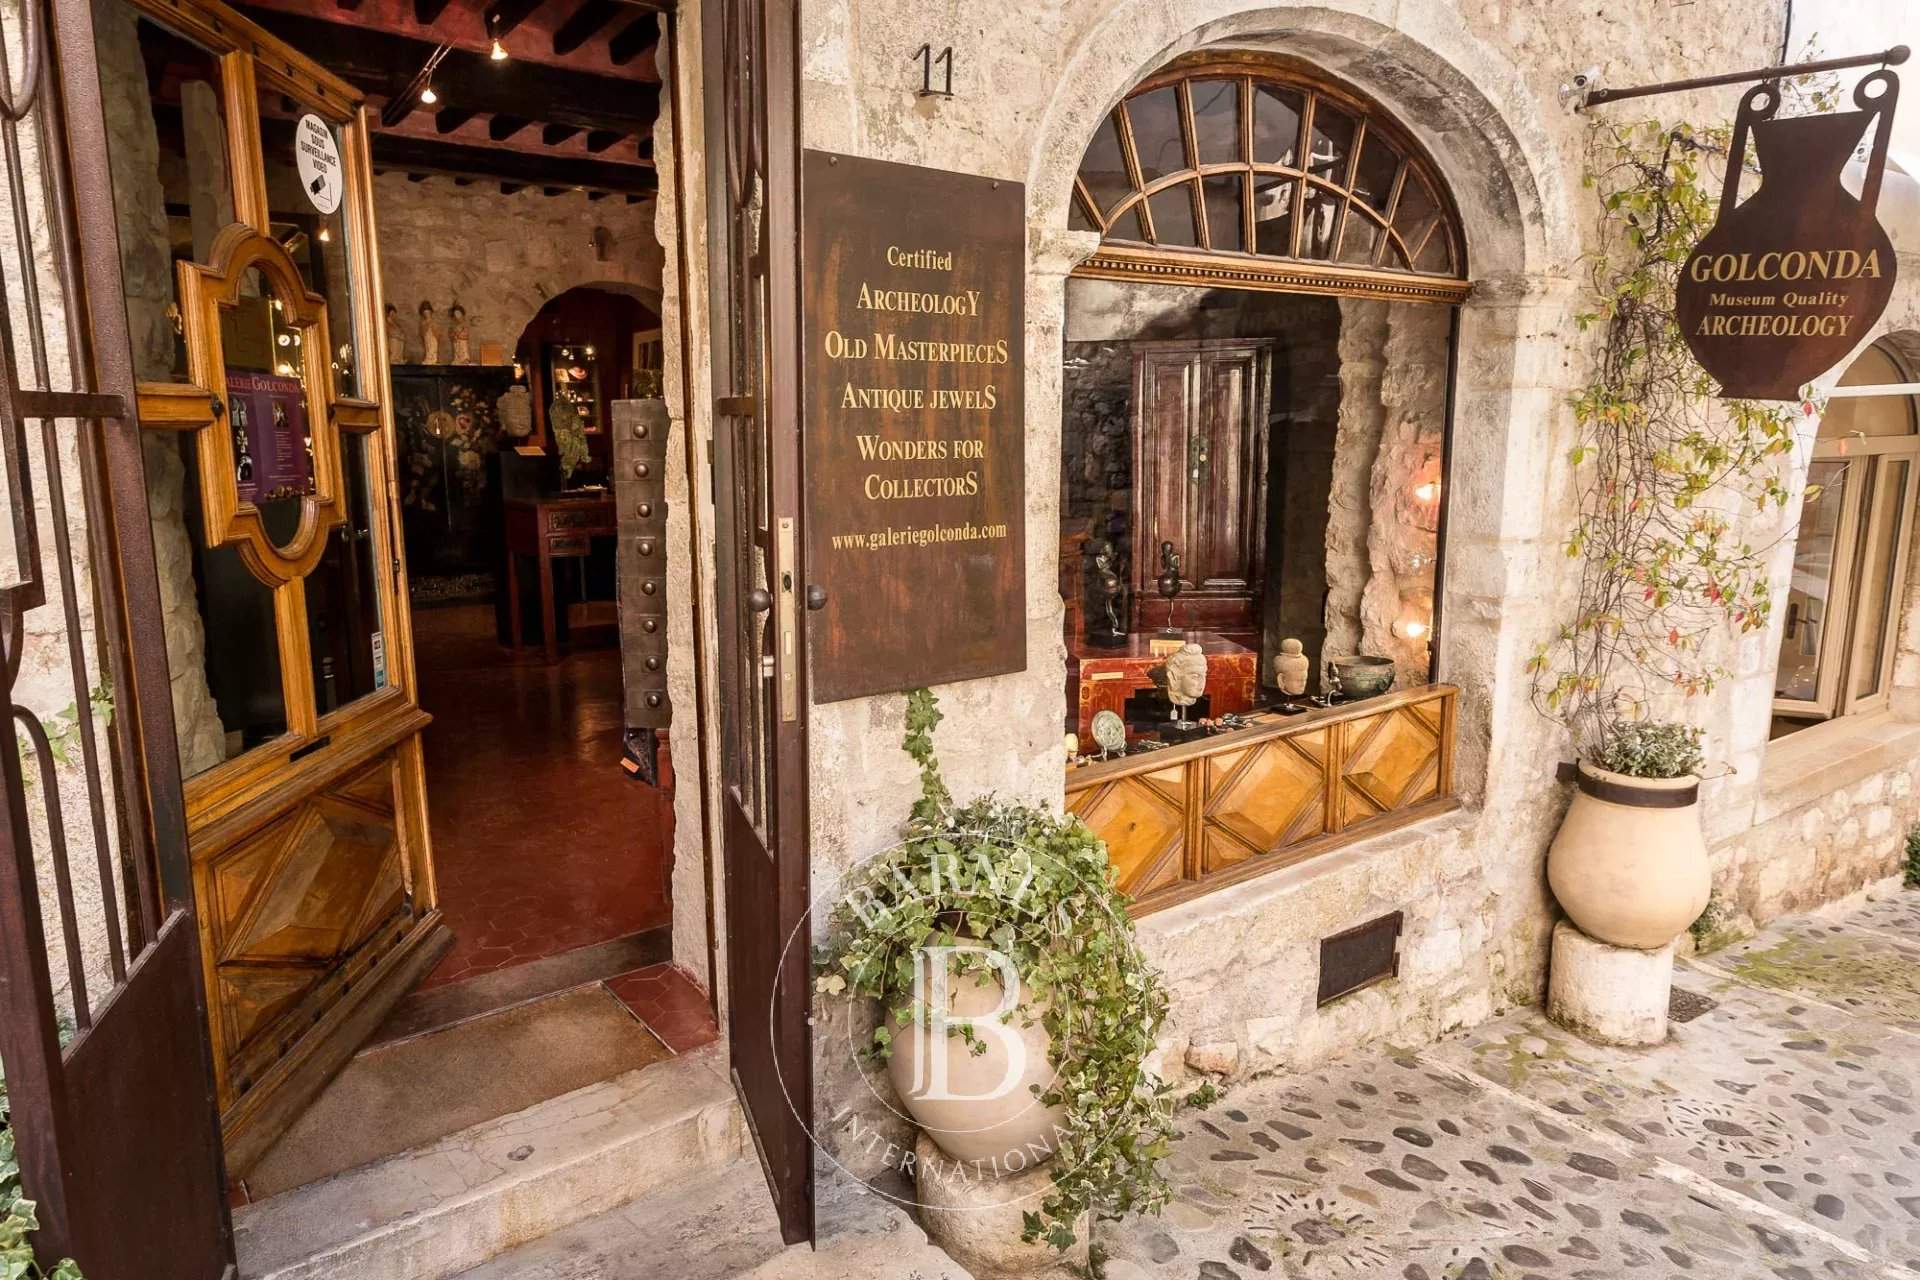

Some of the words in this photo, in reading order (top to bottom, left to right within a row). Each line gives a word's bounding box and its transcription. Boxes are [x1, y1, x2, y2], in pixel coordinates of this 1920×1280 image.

[913, 43, 954, 96] 11
[305, 119, 328, 139] MAGASIN
[311, 134, 325, 149] SOUS
[300, 140, 336, 167] SURVEILLANCE
[886, 245, 953, 271] Certified
[1690, 249, 1882, 283] GOLCONDA
[857, 282, 981, 317] ARCHEOLOGY
[1708, 293, 1776, 307] Museum
[1782, 291, 1849, 308] Quality
[1696, 314, 1855, 337] ARCHEOLOGY
[824, 330, 868, 359] OLD
[873, 332, 1009, 365] MASTERPIECES
[252, 375, 299, 392] GOLCONDA
[840, 382, 925, 413] ANTIQUE
[929, 384, 997, 410] JEWELS
[856, 434, 948, 461] WONDERS
[953, 440, 985, 459] FOR
[864, 470, 979, 500] COLLECTORS
[831, 521, 1008, 551] www.galeriegolconda.com
